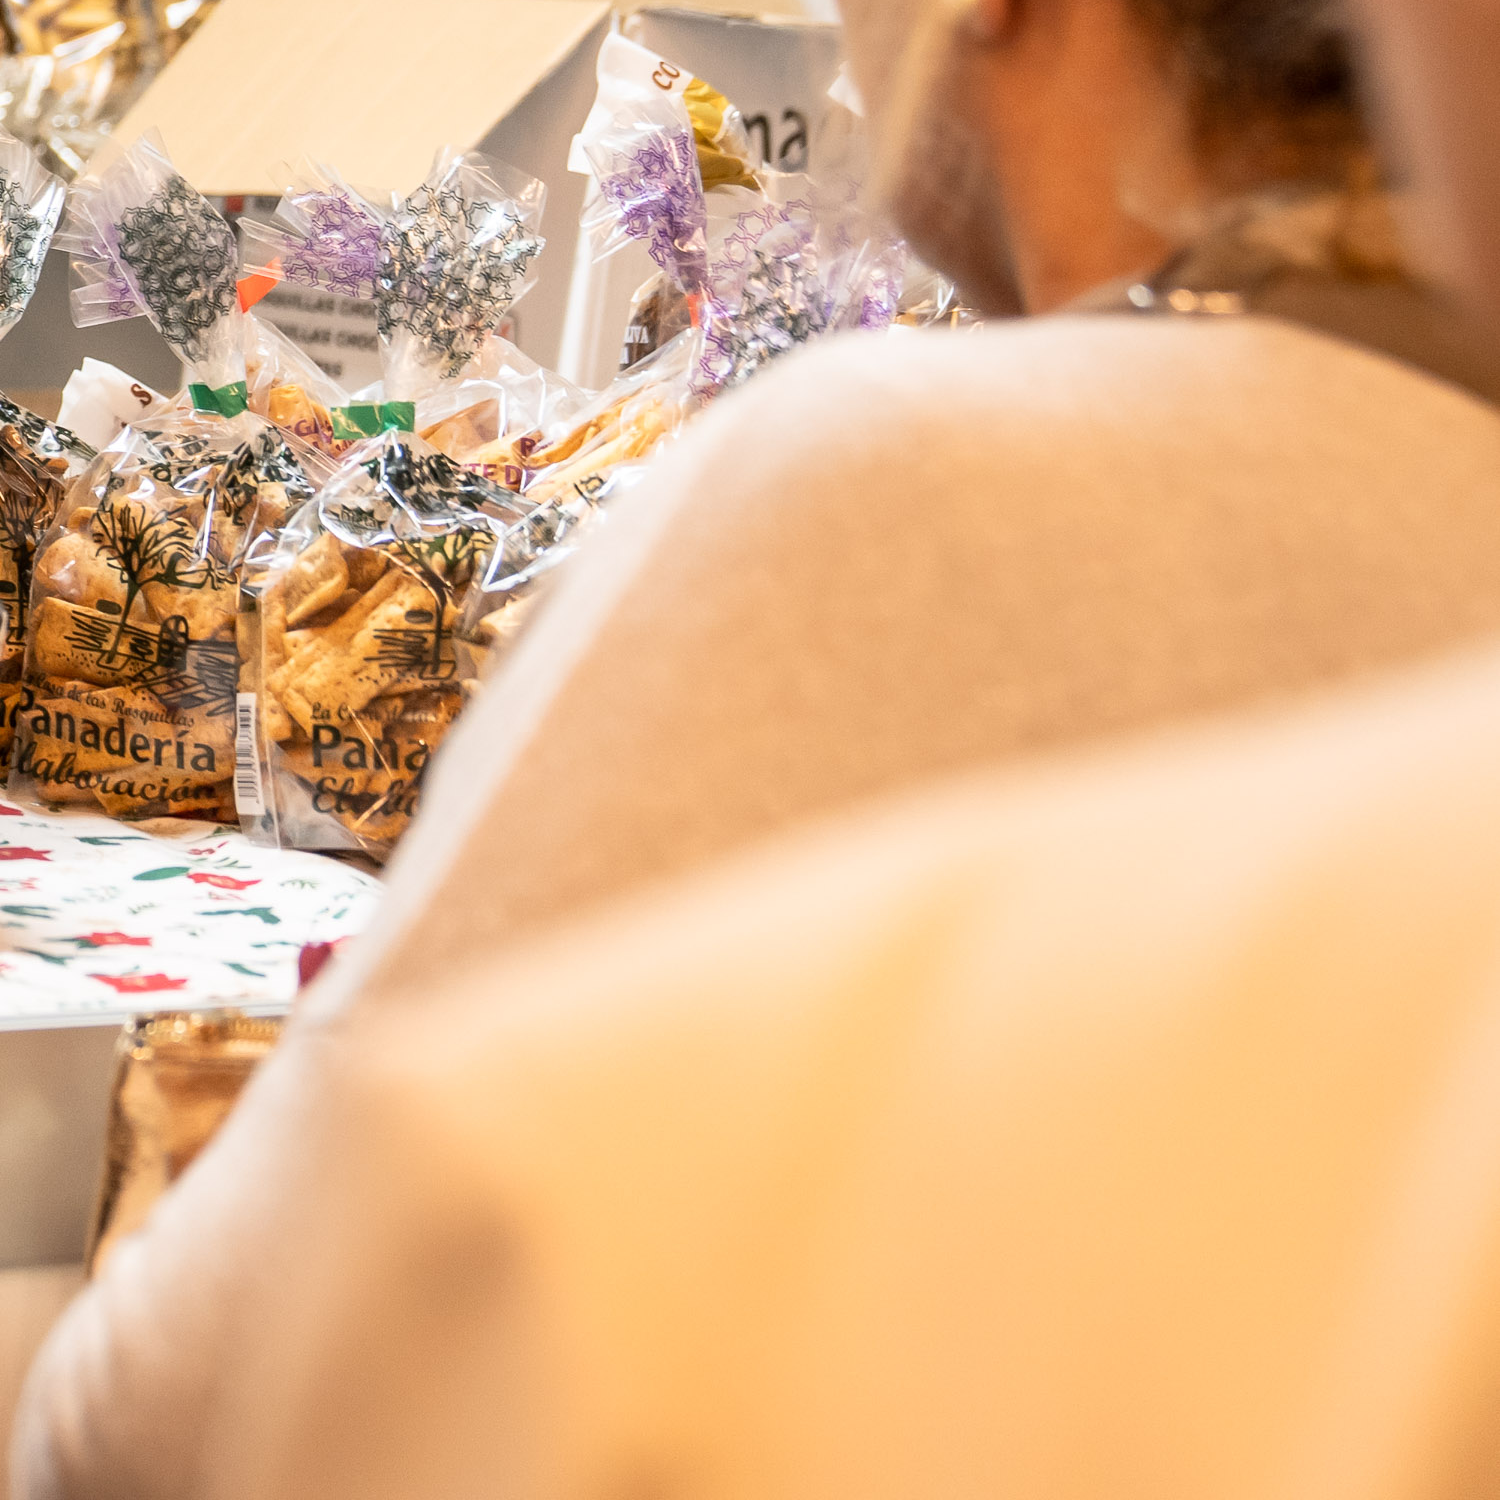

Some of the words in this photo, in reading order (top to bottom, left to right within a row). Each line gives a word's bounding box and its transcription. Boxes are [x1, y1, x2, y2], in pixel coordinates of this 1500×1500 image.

[19, 687, 217, 773] Panadería
[67, 685, 83, 703] de
[85, 694, 107, 712] las
[111, 697, 196, 728] Rosquillas
[312, 722, 430, 771] Pana
